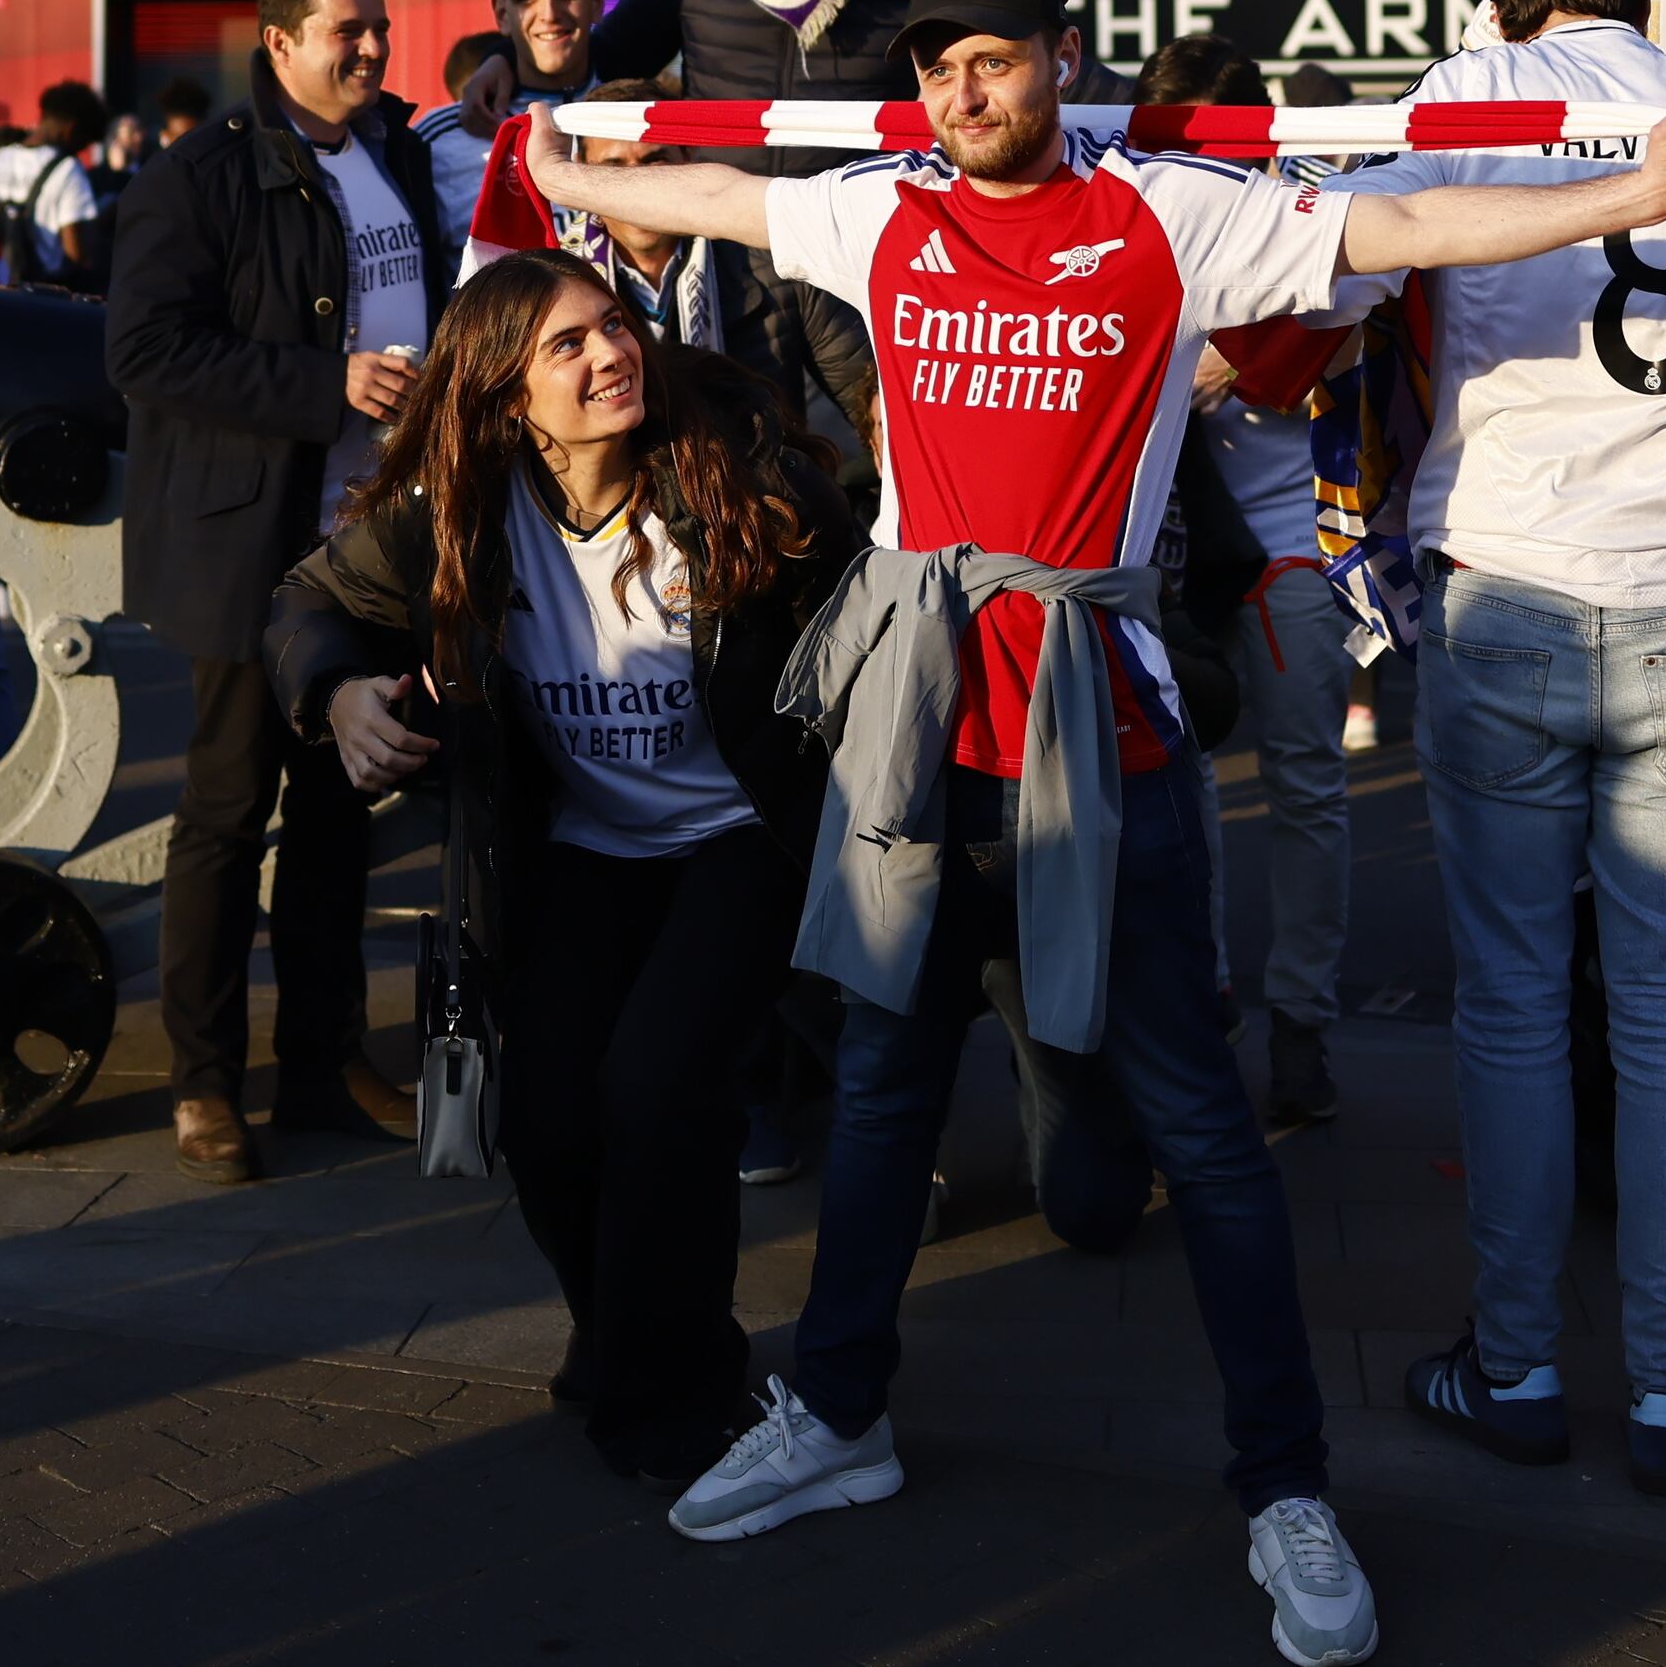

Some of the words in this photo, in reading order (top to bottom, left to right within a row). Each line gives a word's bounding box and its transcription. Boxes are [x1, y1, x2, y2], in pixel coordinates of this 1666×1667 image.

[378, 254, 419, 288] BETTER
[894, 292, 1126, 357] Emirates
[912, 358, 961, 404] FLY
[964, 364, 1084, 412] BETTER
[589, 720, 686, 761] BETTER
